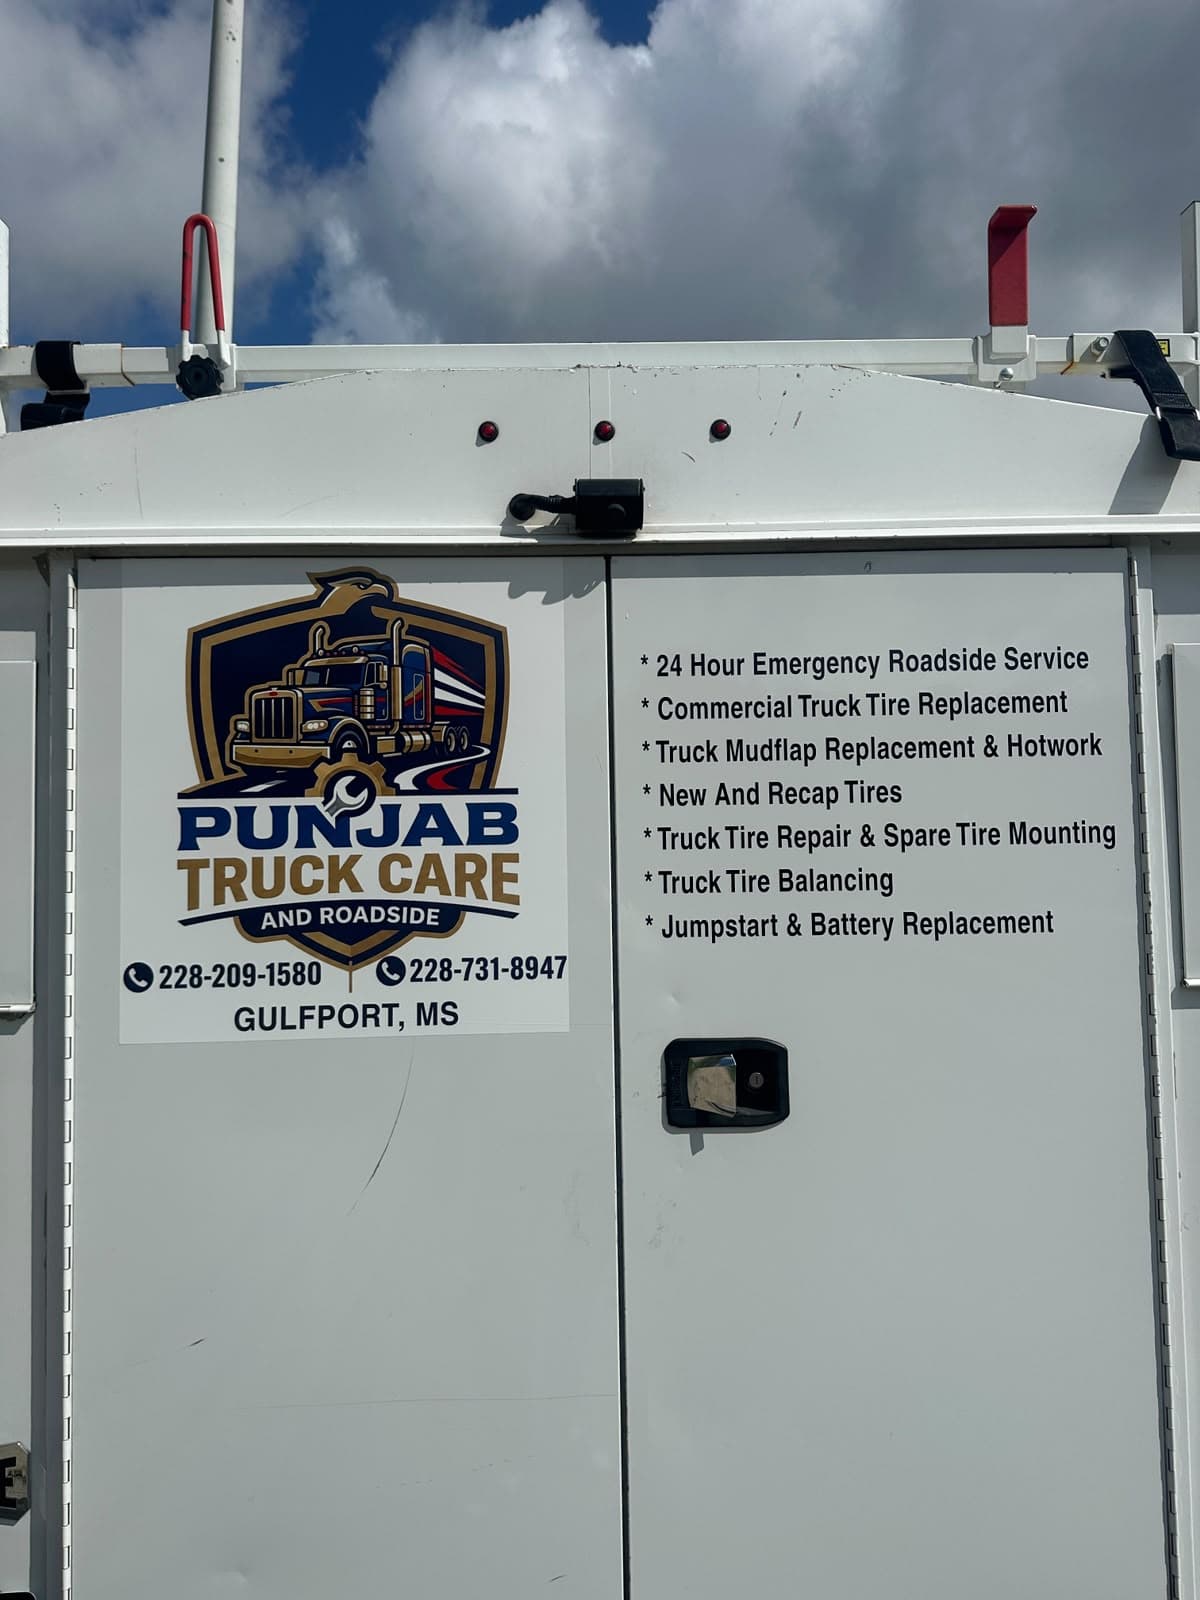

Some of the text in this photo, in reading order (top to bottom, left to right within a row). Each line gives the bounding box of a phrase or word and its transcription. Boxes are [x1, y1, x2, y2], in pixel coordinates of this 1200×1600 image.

[656, 645, 1089, 681] 24 Hour Emergency Roadside Service
[657, 690, 1069, 721] Commercial Truck Tire Replacement
[655, 732, 1103, 768] Truck Mudflap Replacement & Hotwork
[659, 779, 903, 811] New And Recap Tires
[177, 801, 520, 851] PUNJAB
[656, 819, 1116, 855] Truck Tire Repair & Spare Tire Mounting
[177, 852, 521, 911] TRUCK CARE
[657, 867, 894, 898] Truck Tire Balancing
[261, 908, 440, 930] AND ROADSIDE
[661, 910, 1055, 944] Jumpstart & Battery Replacement
[159, 961, 322, 989] 228-209-1580
[410, 955, 568, 982] 228-731-8947
[234, 1001, 459, 1032] GULFPORT, MS
